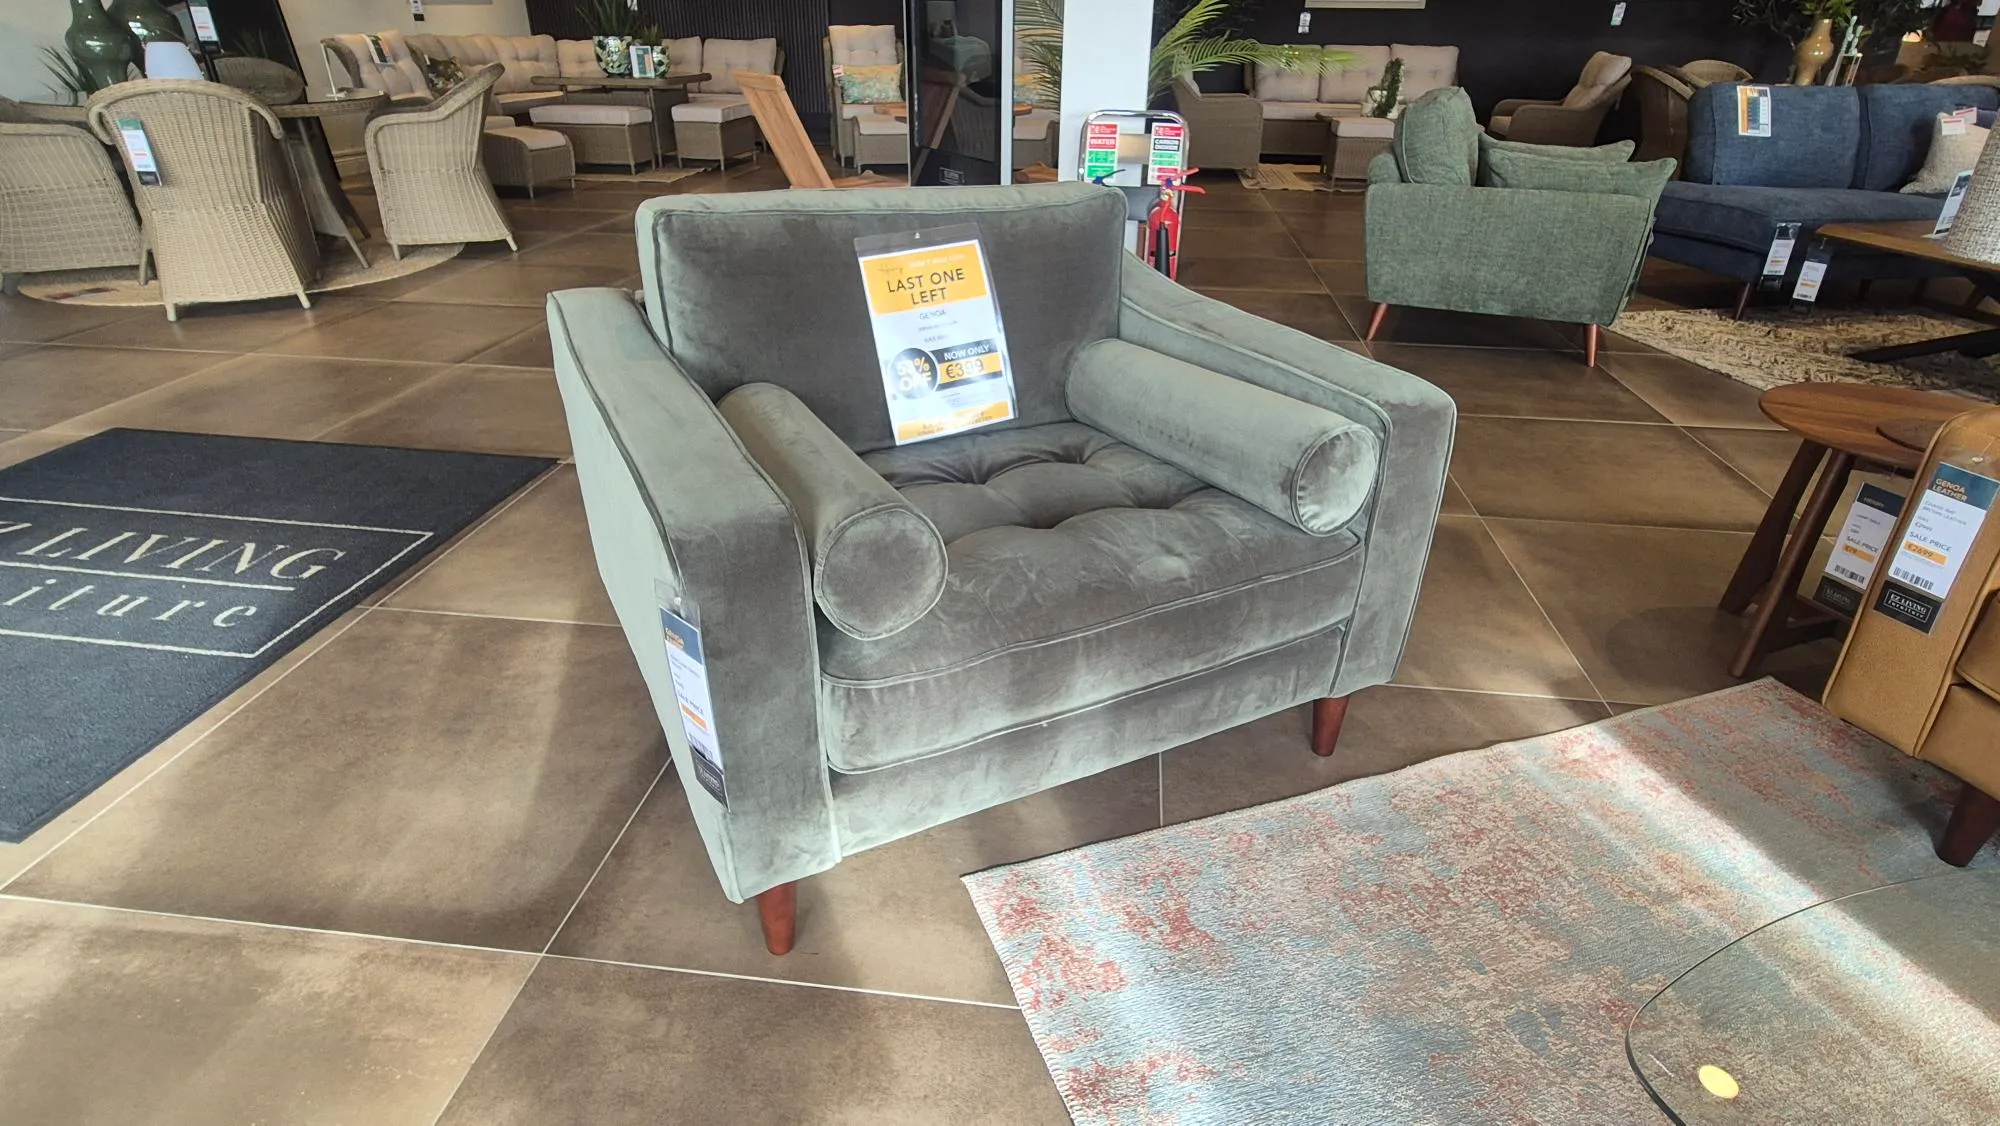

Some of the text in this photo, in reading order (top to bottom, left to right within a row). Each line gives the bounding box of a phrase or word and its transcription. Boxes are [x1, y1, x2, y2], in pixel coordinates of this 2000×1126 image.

[886, 268, 966, 293] LAST ONE
[911, 287, 947, 305] LEFT
[943, 344, 990, 361] NOW ONLY
[946, 358, 985, 379] €399
[1931, 485, 1968, 501] LEATHER
[1935, 478, 1966, 493] GENOA
[1846, 535, 1879, 553] SALE PRICE
[1909, 531, 1952, 552] SALE PRICE
[16, 527, 347, 580] LIVING
[1890, 593, 1928, 615] EZ LIVING
